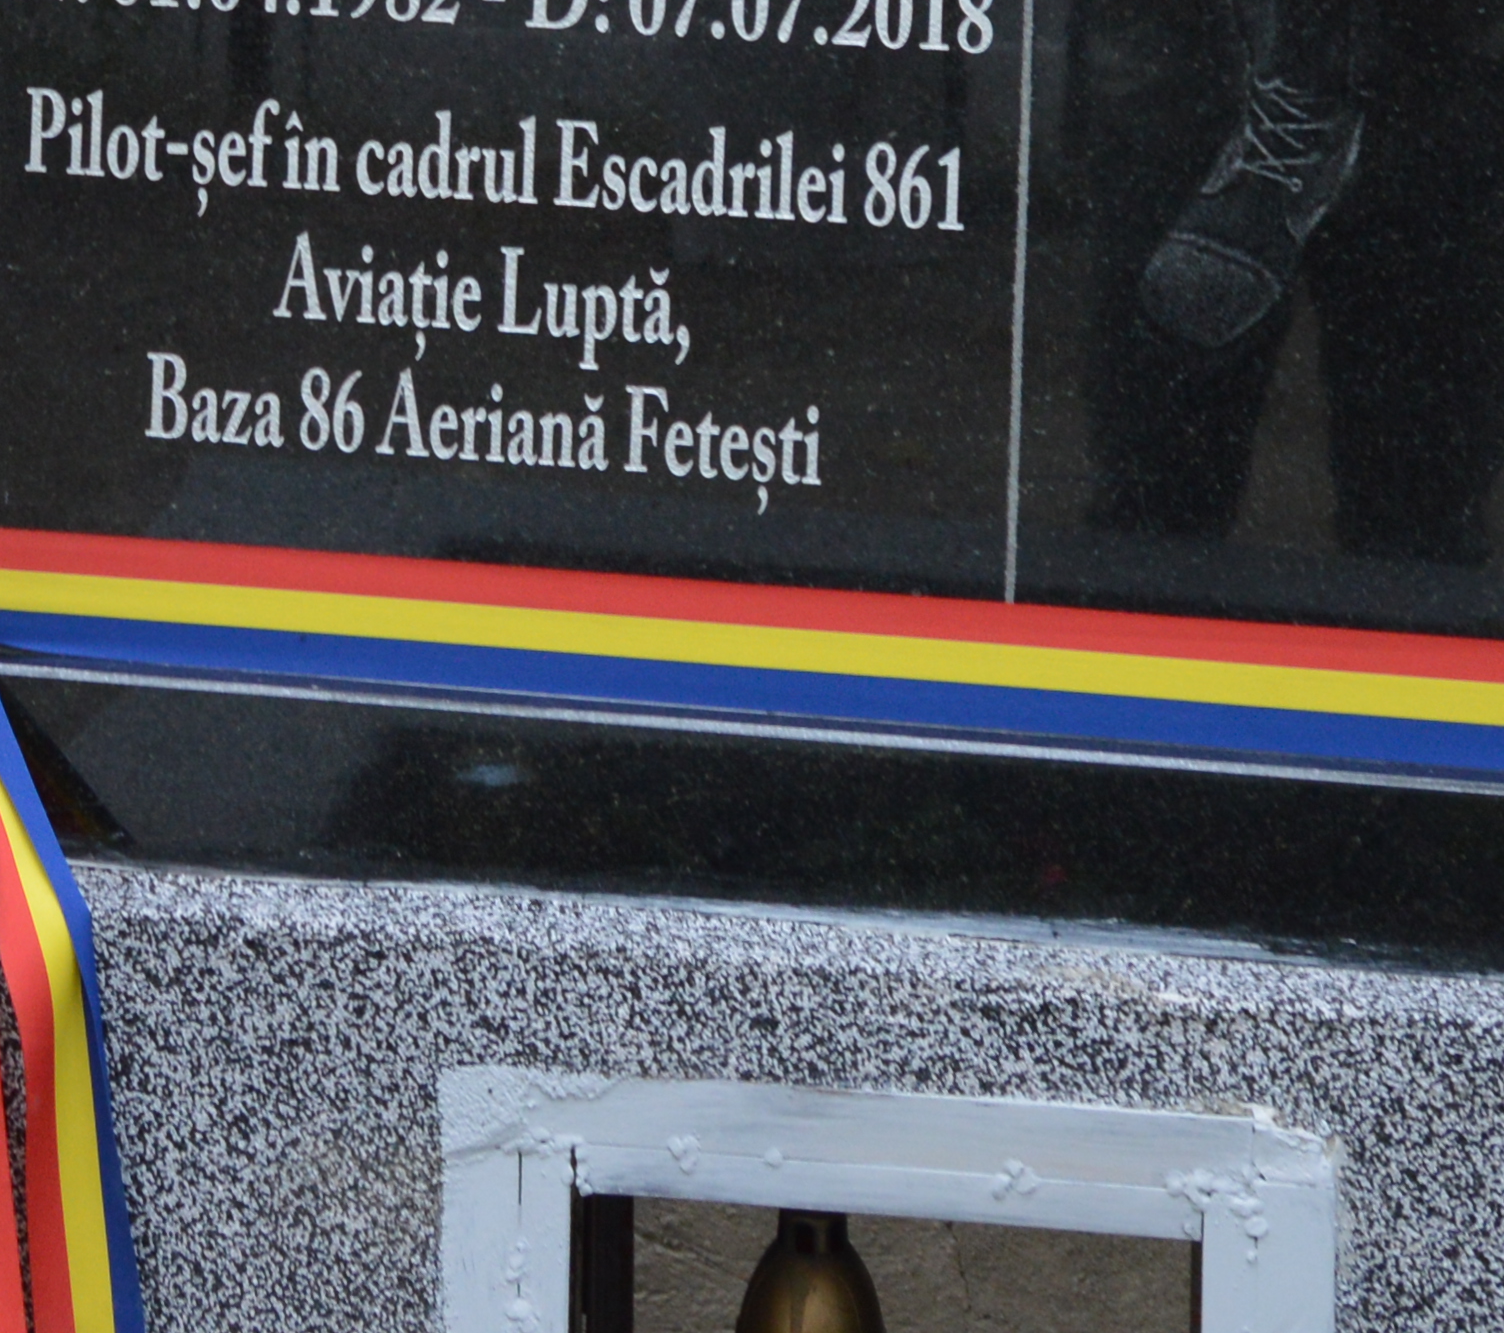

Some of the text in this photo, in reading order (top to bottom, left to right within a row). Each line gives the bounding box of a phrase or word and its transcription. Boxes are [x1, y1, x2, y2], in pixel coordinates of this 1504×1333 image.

[24, 86, 965, 232] Pilot-șef în cadrul Escadrilei 861
[274, 231, 693, 372] Aviație Luptă,
[145, 351, 824, 516] Baza 86 Aeriană Fetești
